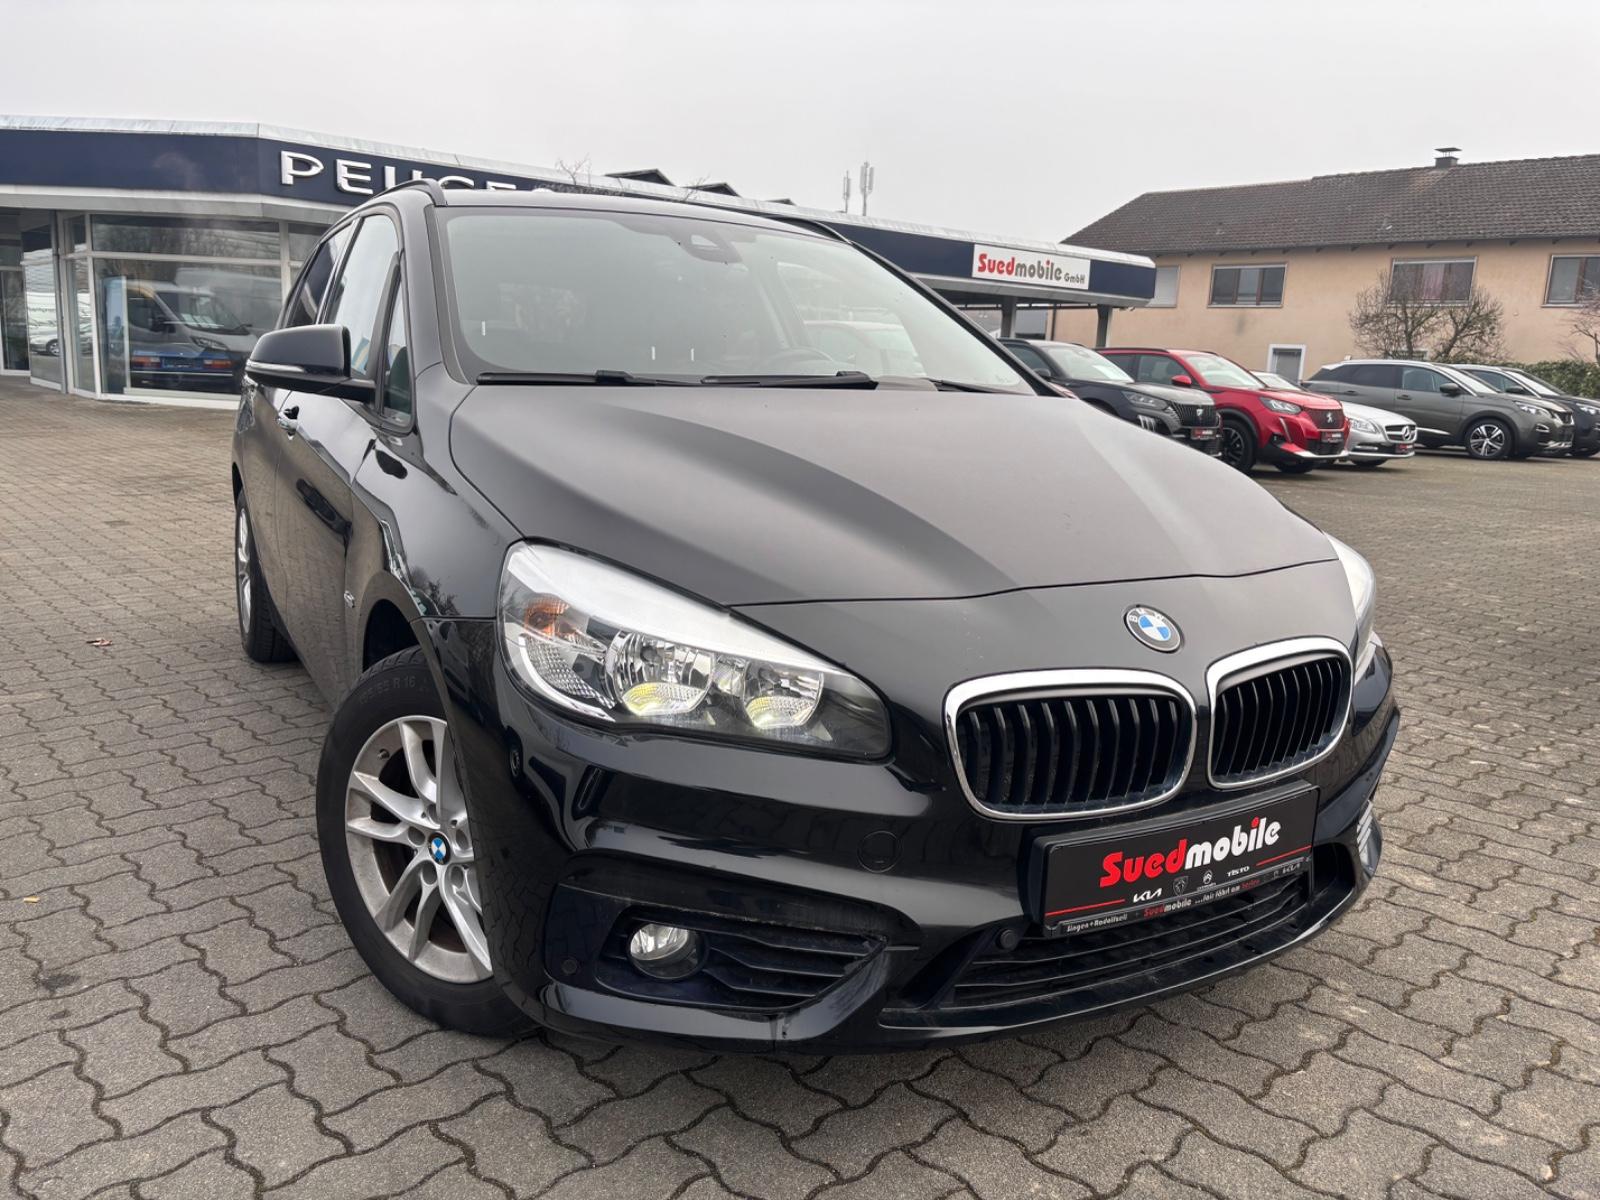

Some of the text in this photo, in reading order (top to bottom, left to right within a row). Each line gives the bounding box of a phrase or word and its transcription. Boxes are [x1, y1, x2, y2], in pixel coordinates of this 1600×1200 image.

[978, 253, 1085, 284] Suedmobile GmbH
[1099, 816, 1282, 888] Suedmobile
[1133, 888, 1163, 903] KIA
[1143, 898, 1192, 917] Suedmobile
